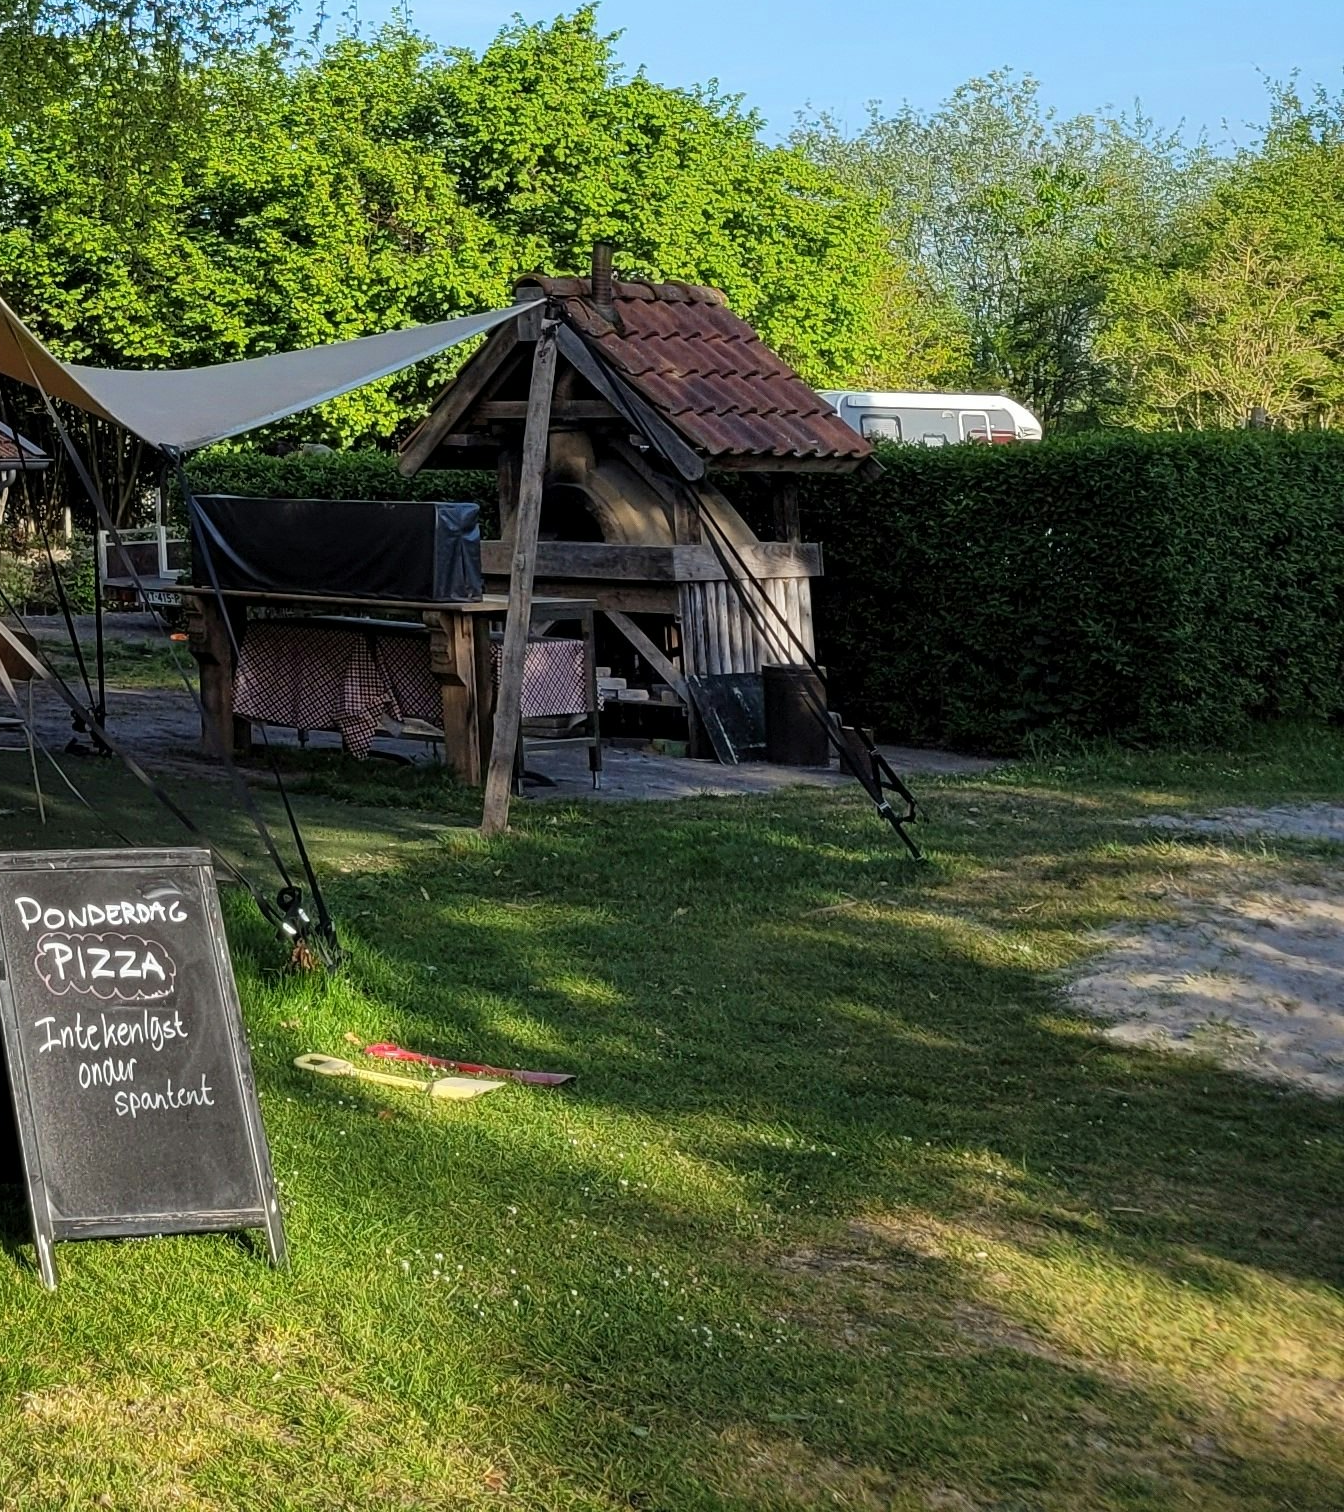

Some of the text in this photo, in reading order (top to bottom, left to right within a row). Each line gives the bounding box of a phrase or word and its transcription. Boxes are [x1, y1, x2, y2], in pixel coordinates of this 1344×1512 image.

[14, 896, 188, 930] DONDERDAG
[42, 942, 166, 981] PIZZA
[78, 1056, 137, 1088] onder
[114, 1073, 215, 1119] spantent
